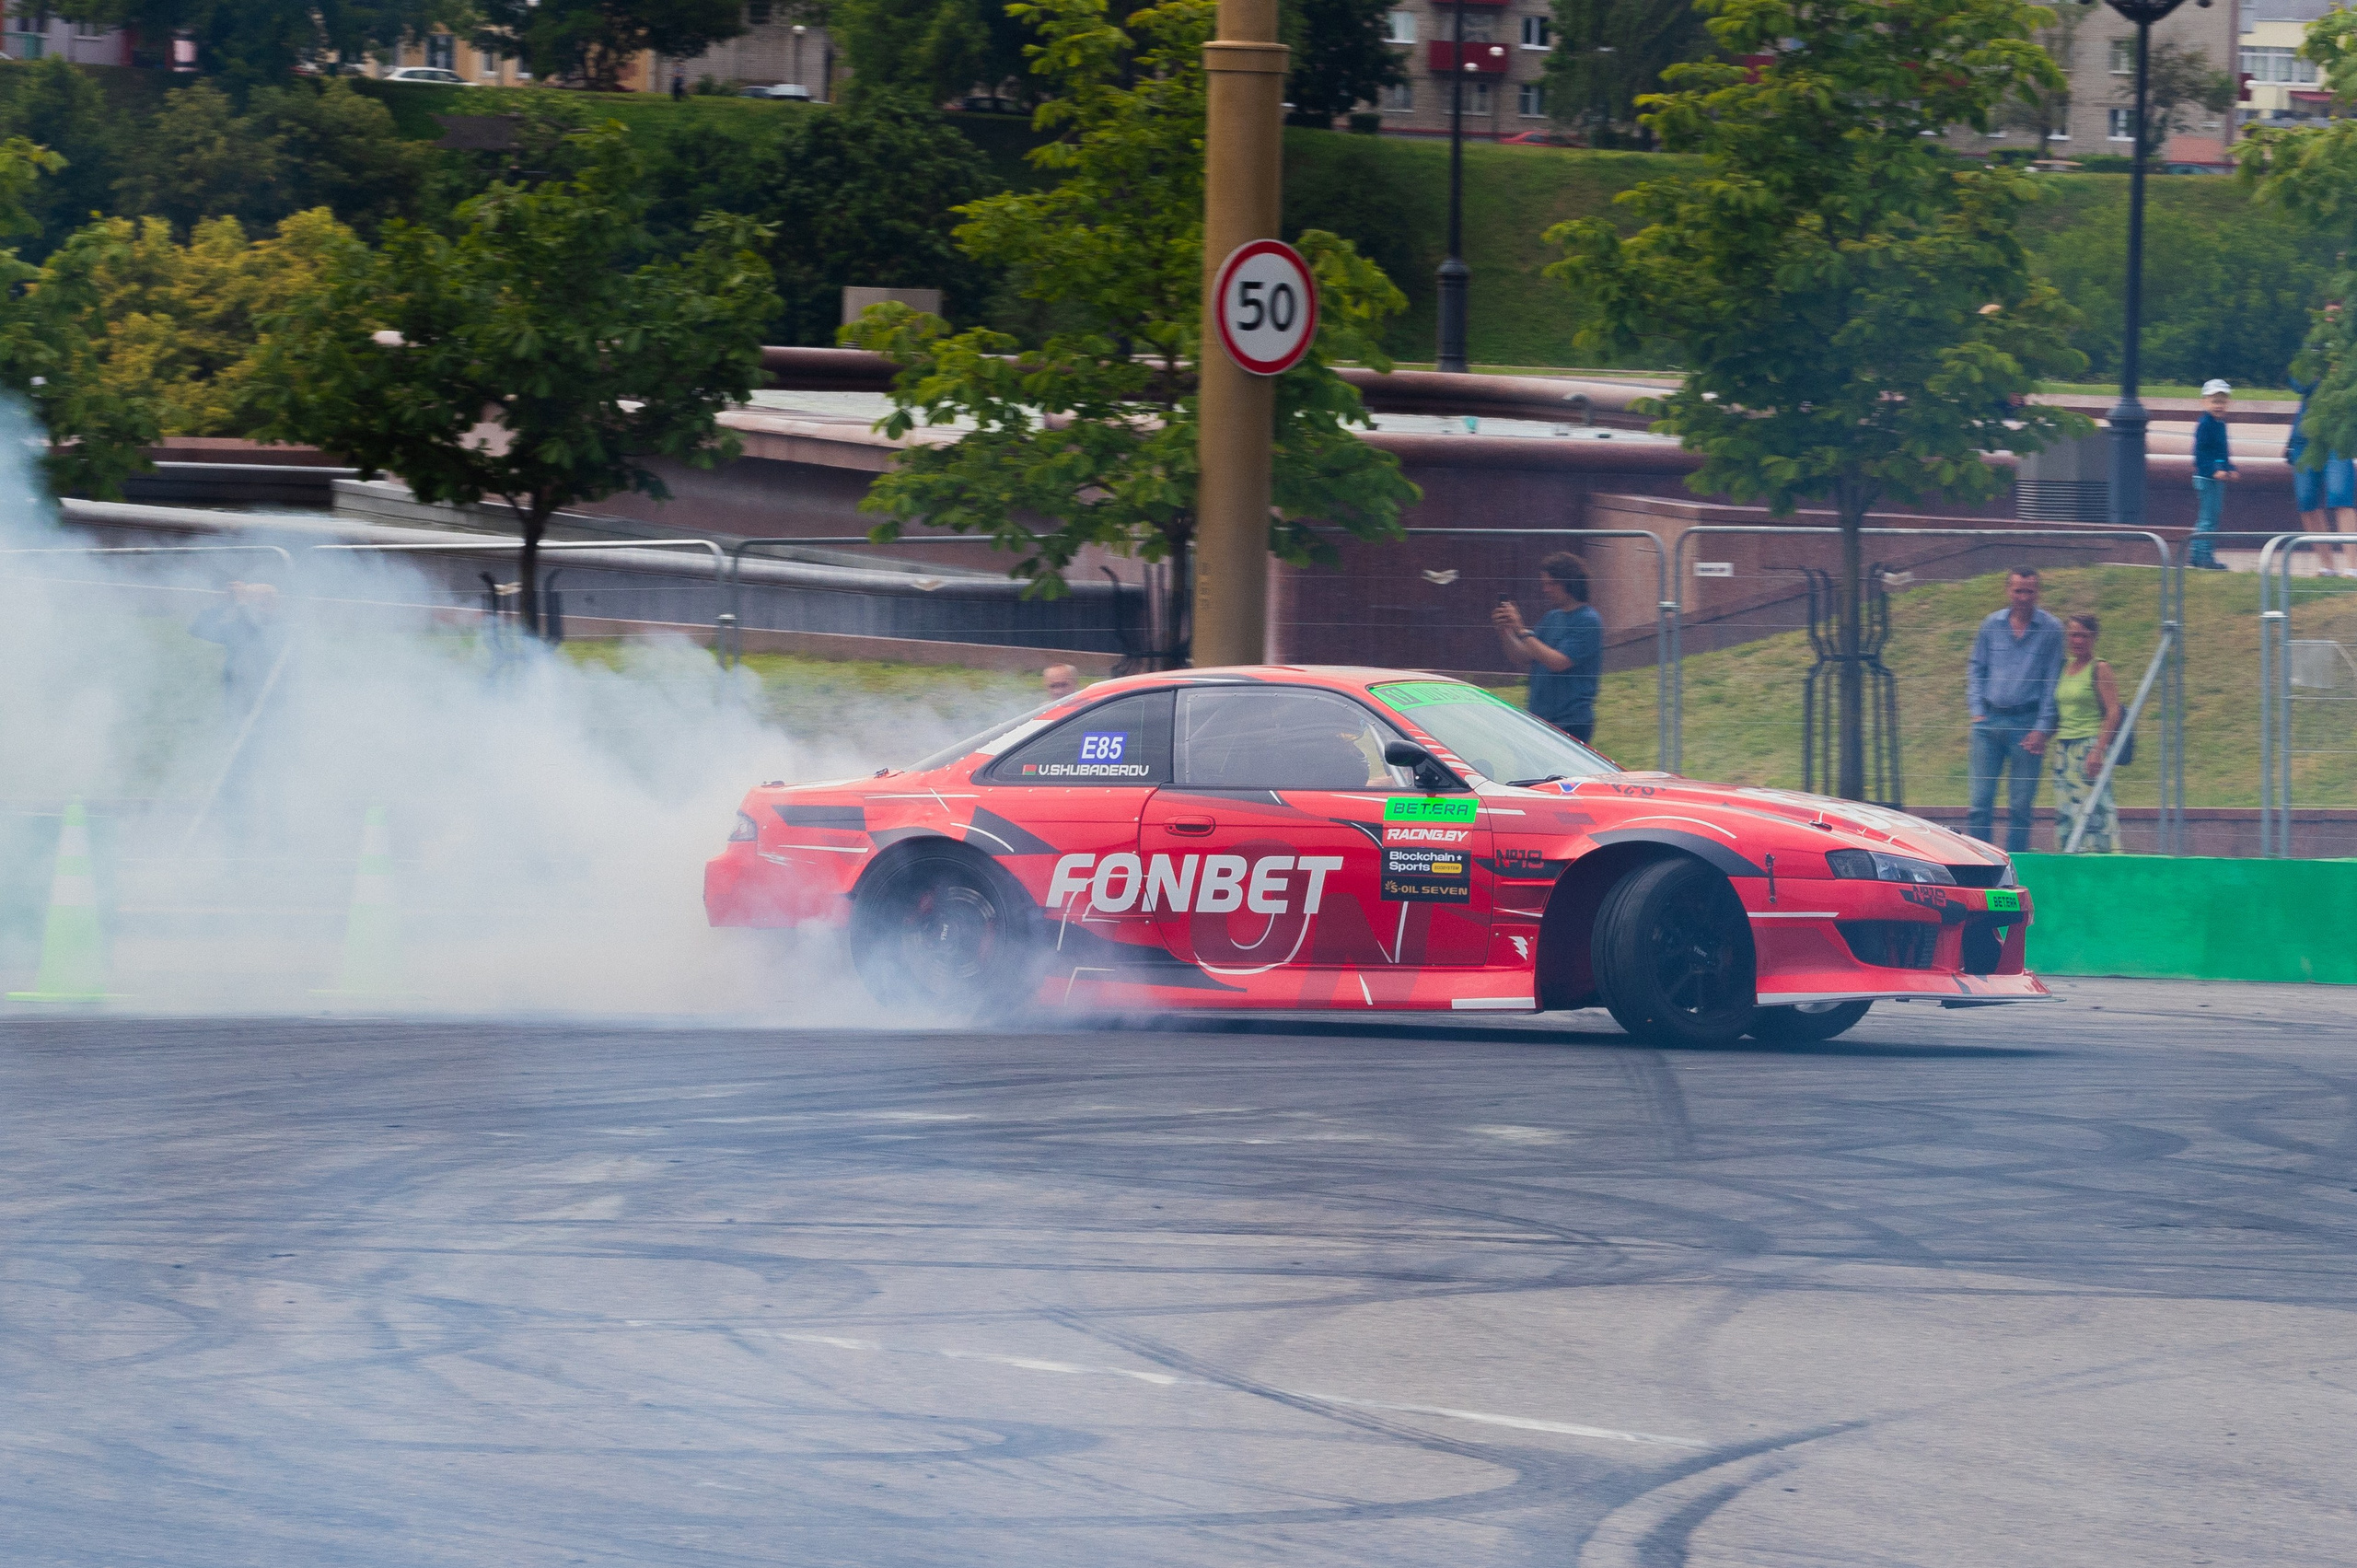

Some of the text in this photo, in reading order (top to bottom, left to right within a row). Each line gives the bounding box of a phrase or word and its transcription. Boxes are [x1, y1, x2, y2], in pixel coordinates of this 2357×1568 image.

[1237, 281, 1296, 331] 50
[1081, 736, 1123, 760] E85
[1038, 764, 1150, 777] V.SHUBADEROV
[1393, 802, 1469, 816] BET.ERA
[1387, 829, 1469, 842] RACING.BY
[1389, 851, 1456, 862] Blockchain
[1388, 861, 1431, 872] Sports
[1045, 853, 1343, 914] FONBET
[1389, 884, 1468, 896] S-OIL SEVEN
